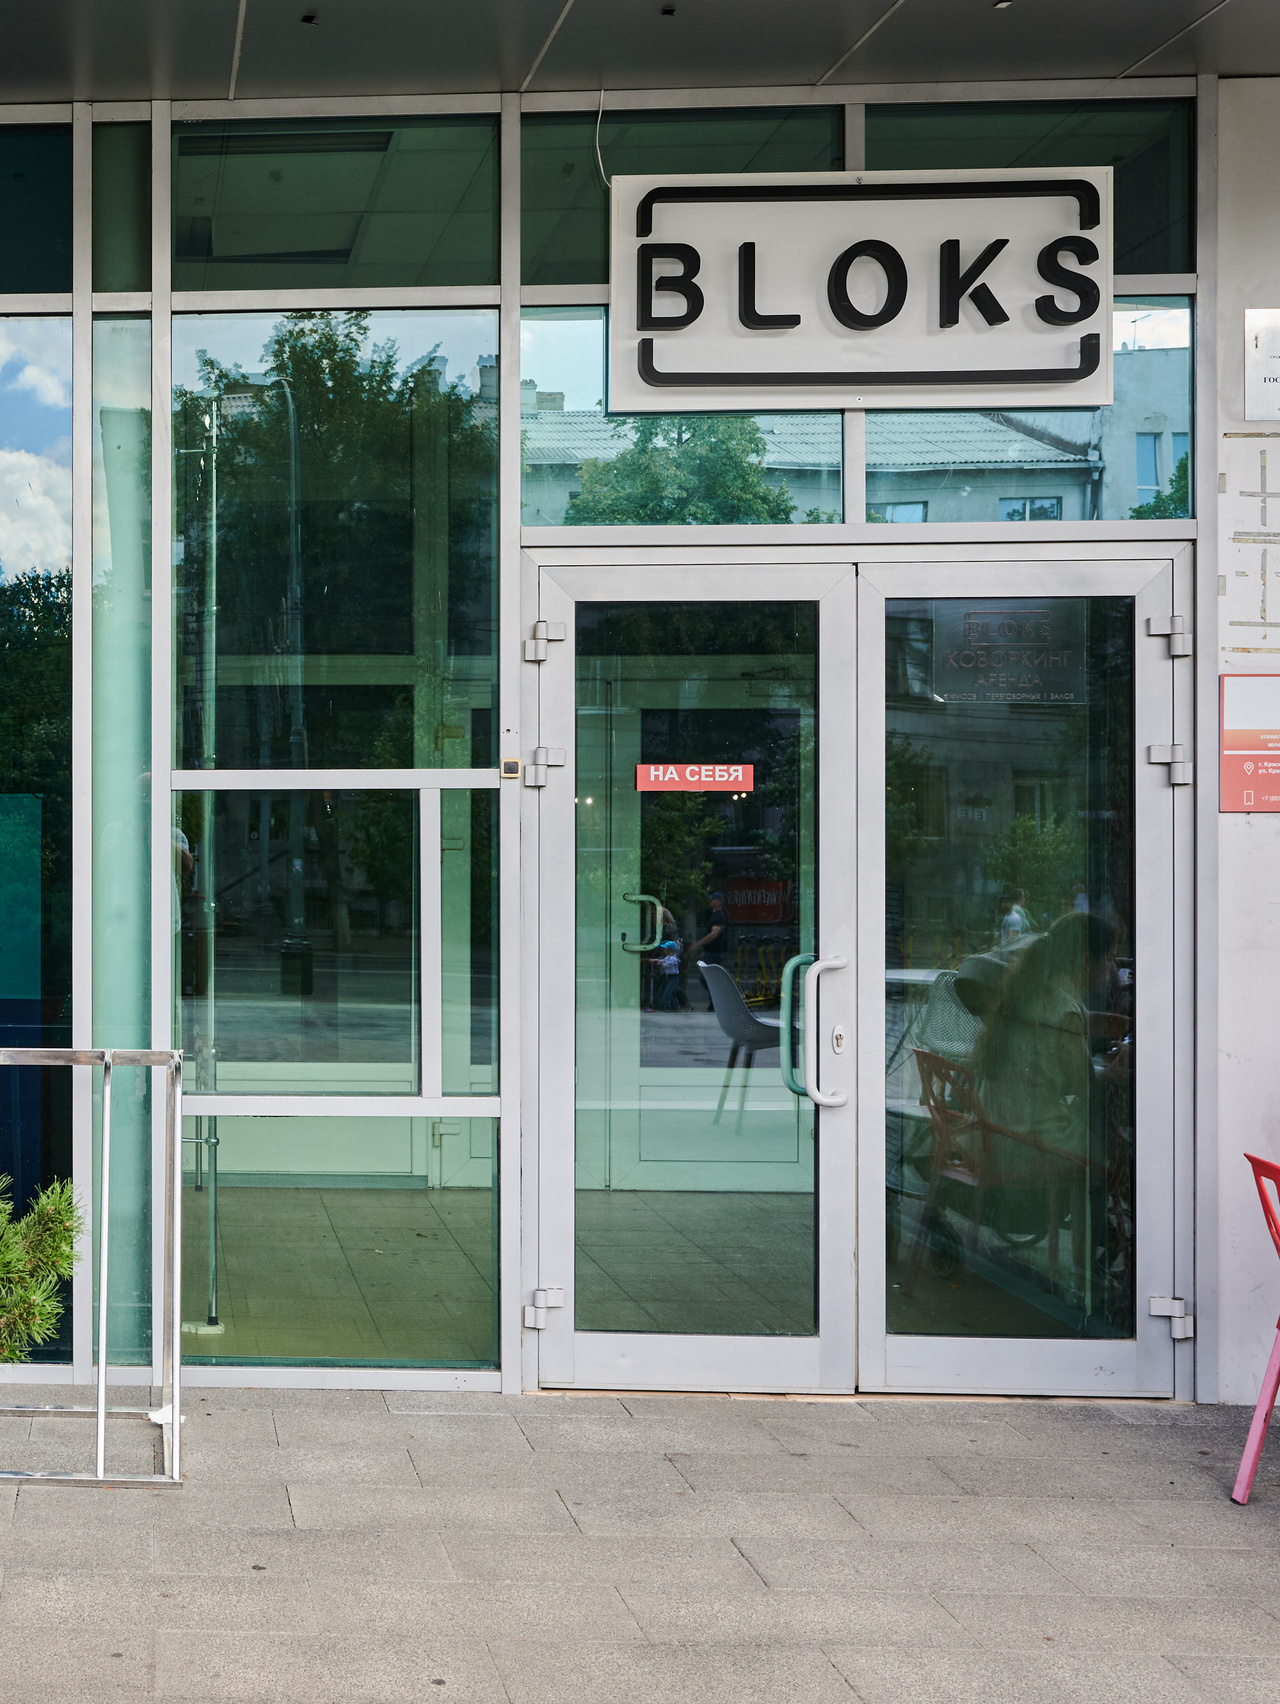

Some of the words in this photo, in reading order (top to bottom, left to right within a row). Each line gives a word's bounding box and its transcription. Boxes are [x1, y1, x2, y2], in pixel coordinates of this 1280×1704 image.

[637, 235, 1100, 331] BLOKS
[968, 620, 1051, 637] BLOKS
[946, 650, 1072, 668] КОВОРКИНГ
[976, 673, 1042, 688] АРЕНДА
[1050, 692, 1075, 700] ЗАЛОВ
[650, 766, 679, 781] НА
[685, 766, 743, 781] СЕБЯ
